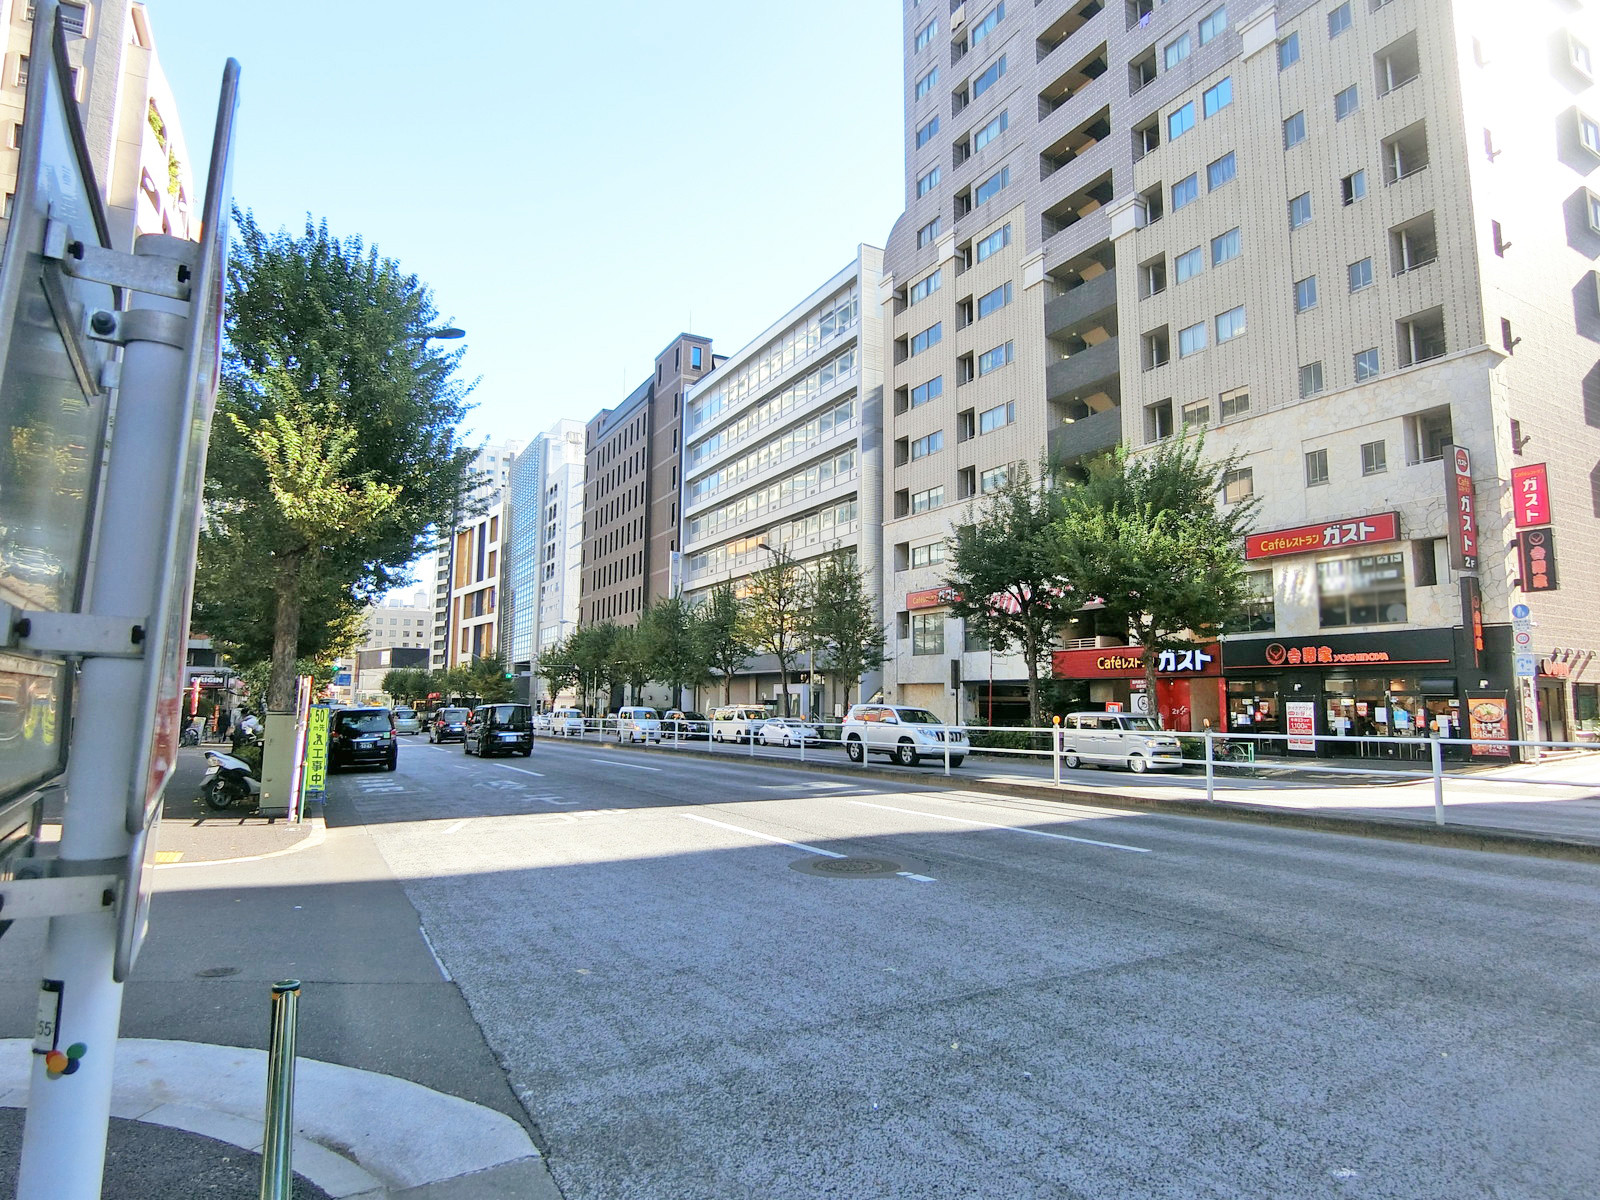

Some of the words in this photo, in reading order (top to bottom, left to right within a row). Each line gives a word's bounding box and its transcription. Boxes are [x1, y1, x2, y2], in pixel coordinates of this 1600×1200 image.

[1522, 477, 1539, 523] ガスト
[1323, 521, 1375, 546] ガスト
[1461, 495, 1473, 552] ガスト
[1464, 556, 1475, 568] 2F
[1158, 648, 1212, 672] ガスト
[1333, 652, 1389, 663] YOSHINOYA
[315, 709, 325, 723] 50
[311, 748, 323, 784] 工事中
